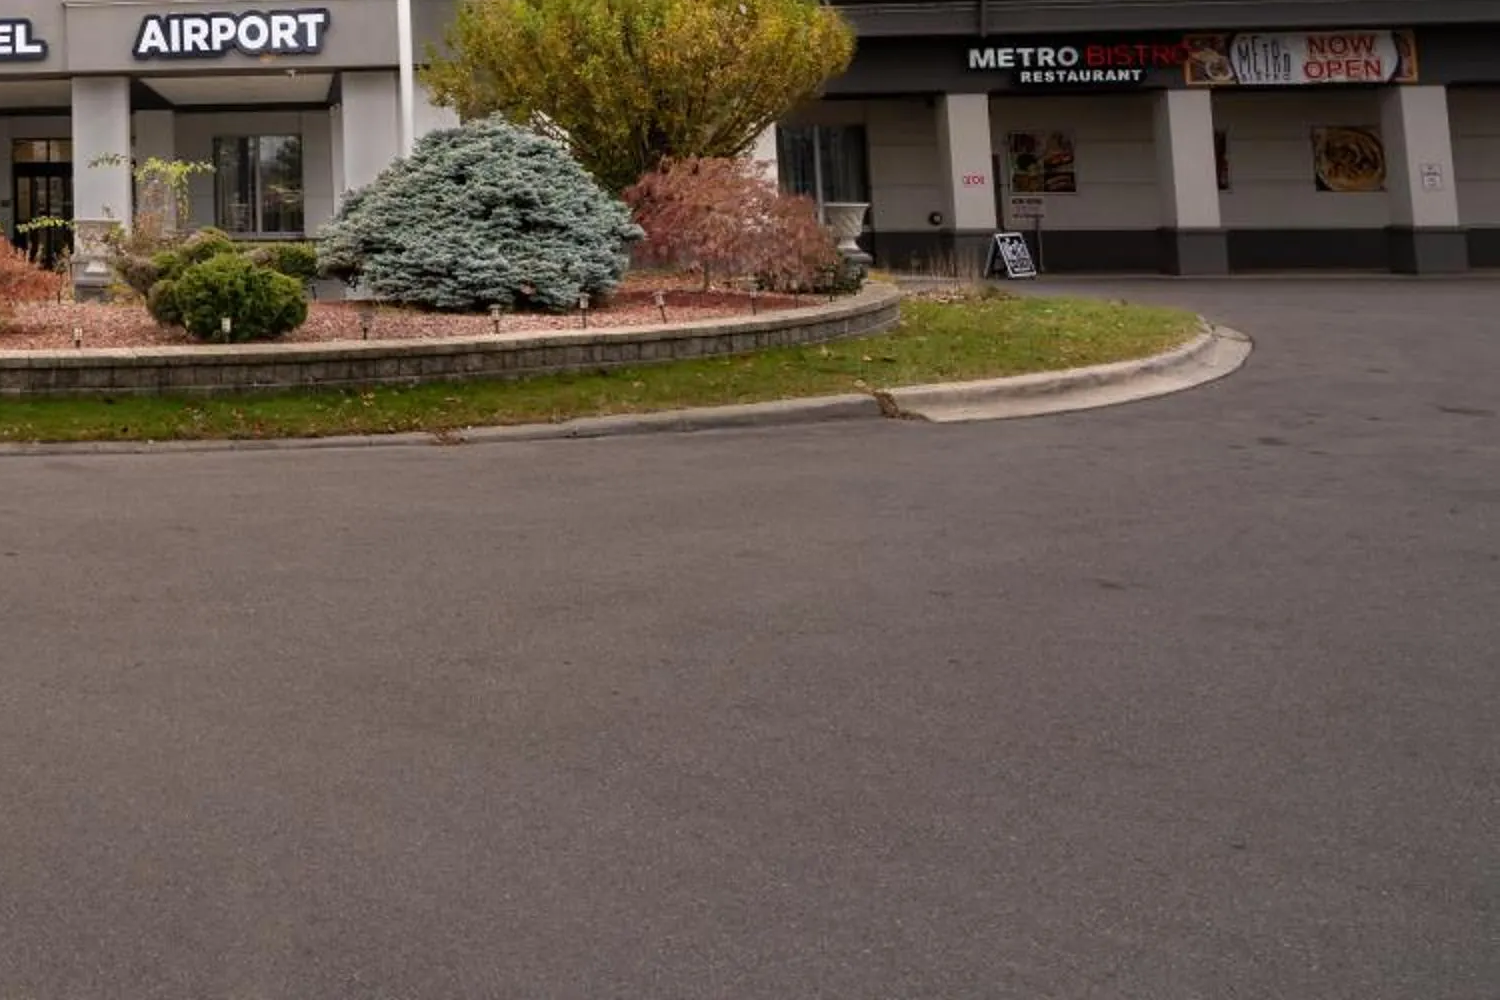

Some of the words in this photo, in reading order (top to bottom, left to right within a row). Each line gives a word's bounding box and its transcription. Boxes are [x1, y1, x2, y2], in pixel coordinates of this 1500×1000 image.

[137, 13, 325, 54] AIRPORT
[1306, 35, 1376, 54] NOW
[968, 46, 1079, 69] METRO
[1303, 57, 1382, 79] OPEN
[1020, 69, 1143, 83] RESTAURANT
